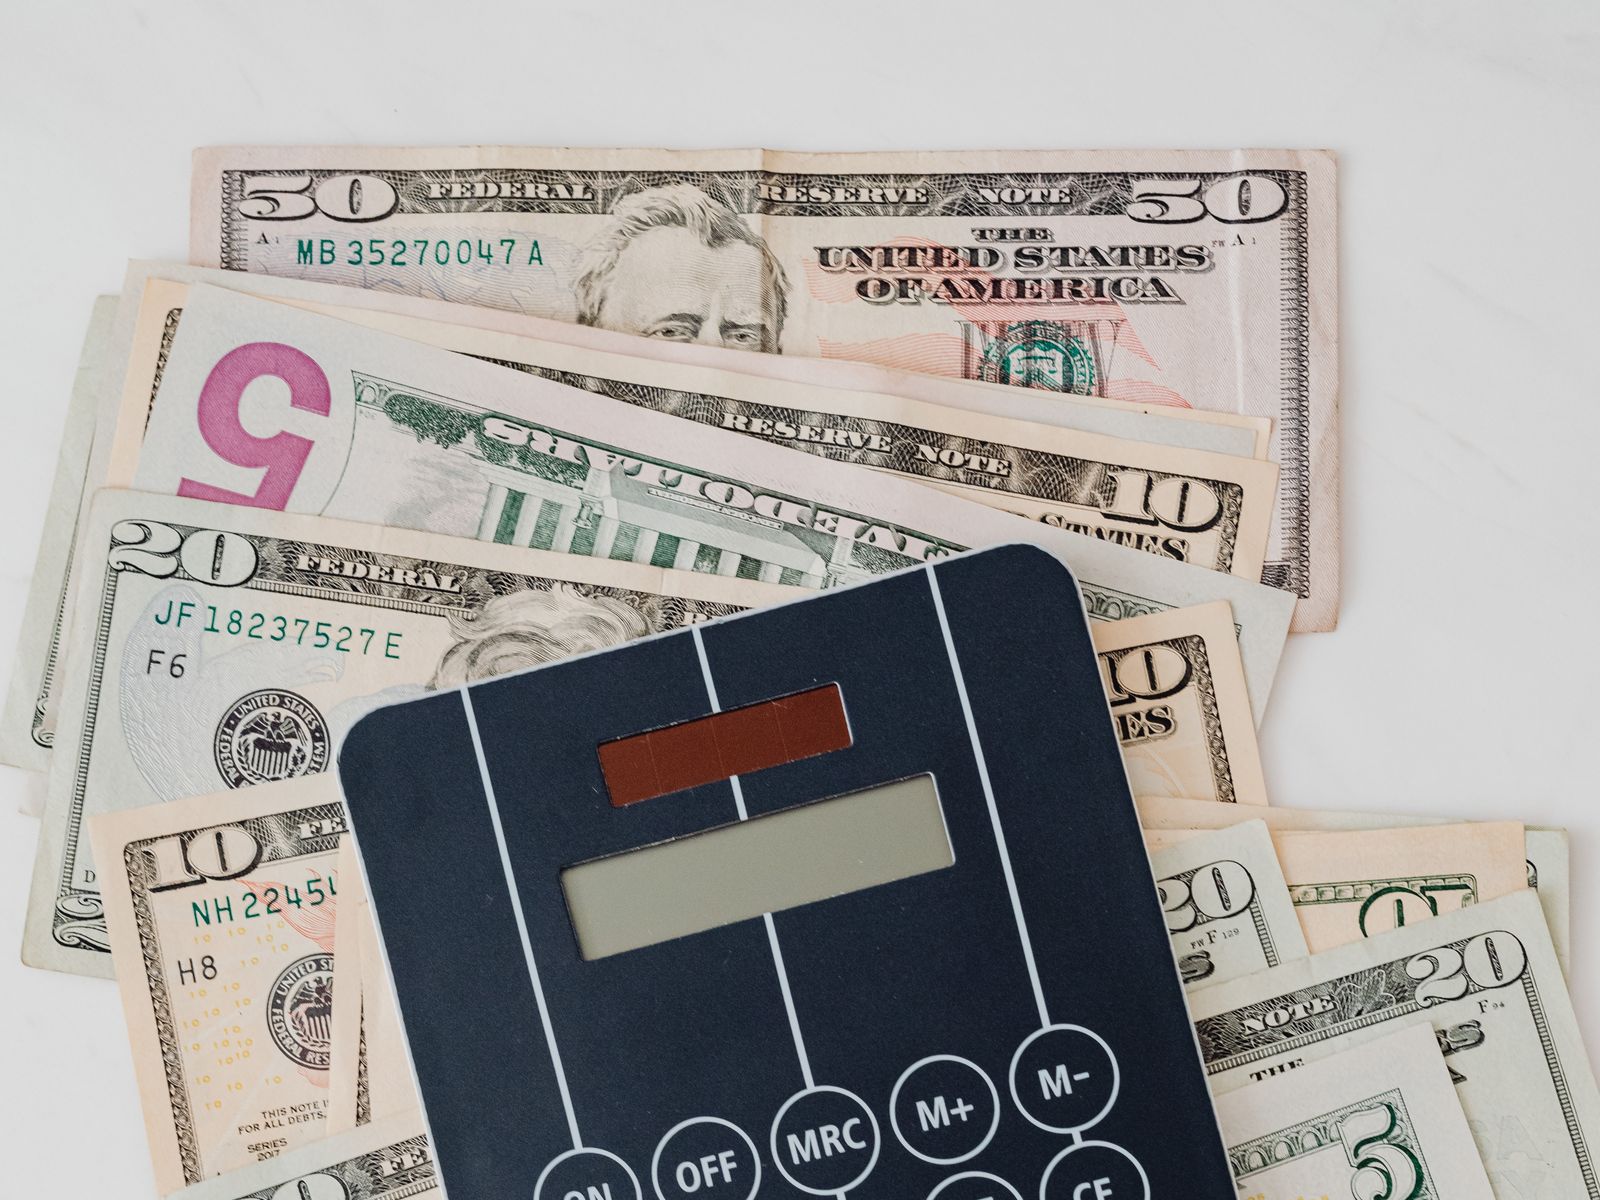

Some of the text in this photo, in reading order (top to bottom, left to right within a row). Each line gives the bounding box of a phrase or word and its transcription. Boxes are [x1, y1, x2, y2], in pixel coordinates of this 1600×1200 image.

[239, 173, 1290, 225] 50 FEDERAL RESERVE NOTE 50
[970, 227, 1055, 243] THE
[812, 244, 1216, 275] UNITED STATES
[932, 276, 1187, 306] AMERICA
[176, 341, 332, 513] 5
[481, 413, 816, 528] DOLLARS
[720, 411, 1224, 533] RESERVE NOTE 10
[108, 518, 463, 593] 20 FEDERAL
[146, 649, 188, 678] F6
[233, 694, 321, 731] UNITED STATES
[219, 727, 240, 784] FEDERAL
[143, 824, 264, 893] 10
[177, 955, 217, 986] H8
[276, 960, 317, 997] UNITED
[1242, 930, 1529, 1036] NOTE 20
[271, 1007, 304, 1059] FEDERAL
[1037, 1063, 1090, 1101] M-
[1249, 1057, 1306, 1082] THE
[238, 1123, 262, 1135] FOR
[264, 1119, 287, 1130] ALL
[262, 1100, 321, 1120] THIS NOTE
[915, 1095, 974, 1132] M+
[247, 1137, 288, 1154] SERIES
[786, 1117, 867, 1165] MRC
[675, 1150, 738, 1193] OFF
